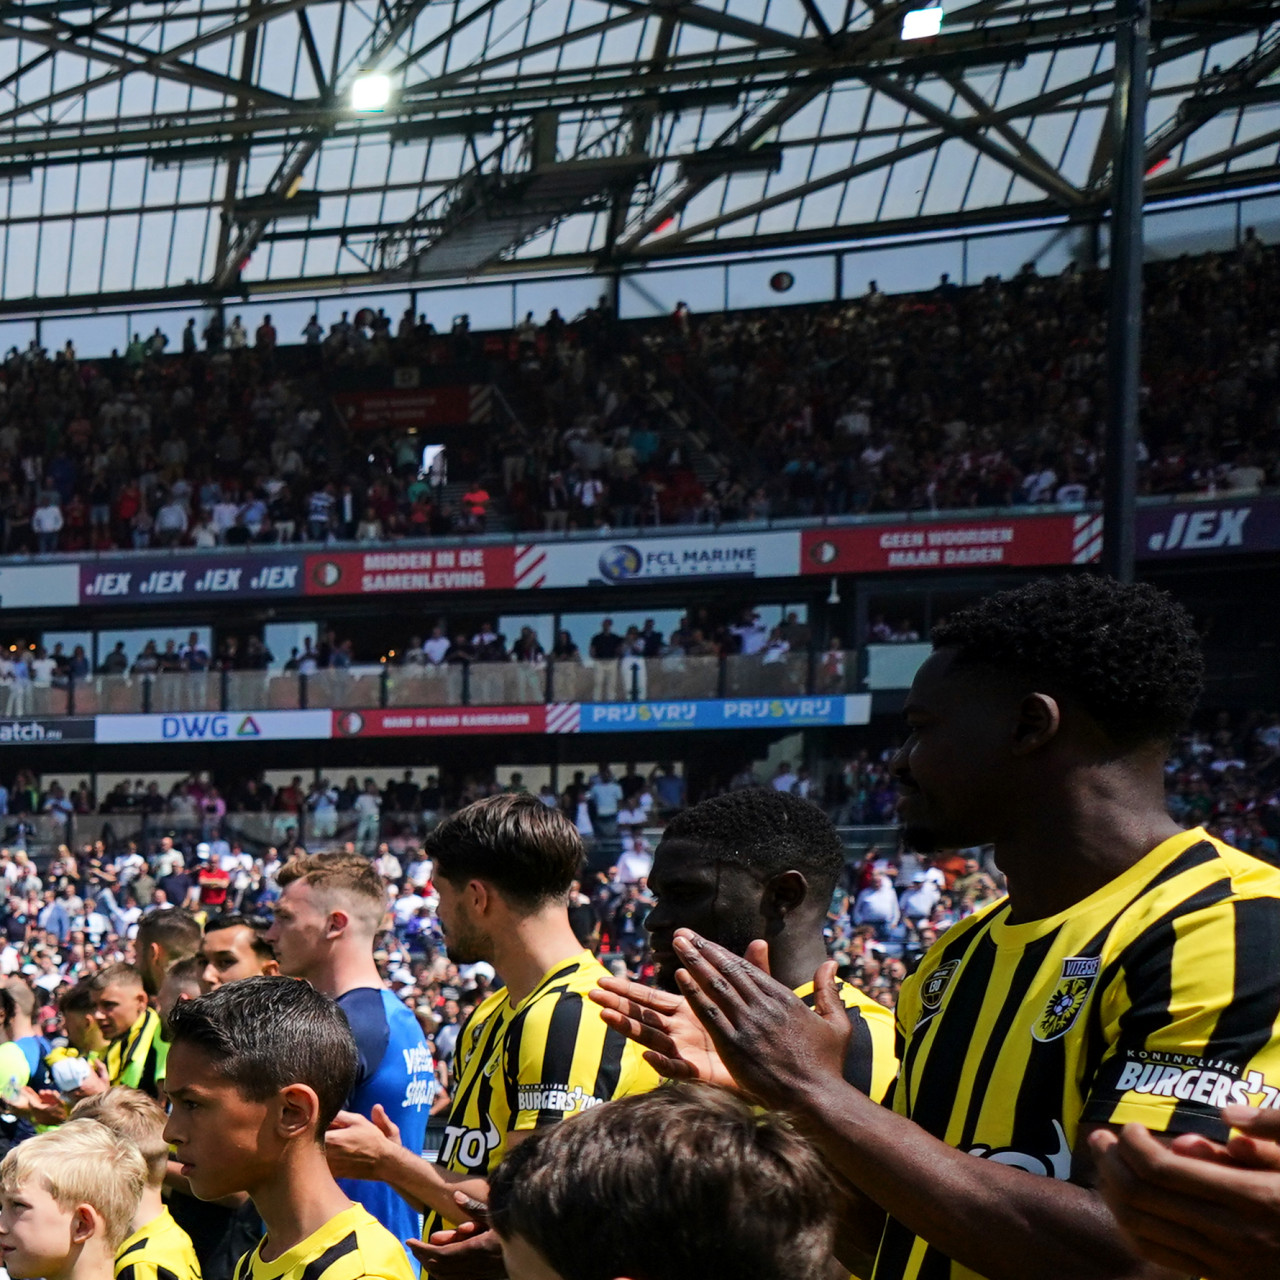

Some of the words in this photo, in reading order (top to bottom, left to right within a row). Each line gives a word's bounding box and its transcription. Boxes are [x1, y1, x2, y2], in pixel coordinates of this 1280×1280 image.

[363, 553, 432, 570] MIDDEN
[436, 551, 455, 568] IN
[460, 550, 484, 567] DE
[682, 547, 756, 563] MARINE
[361, 571, 485, 592] SAMENLEVING
[161, 715, 229, 740] DWG
[1065, 959, 1100, 977] VITESSE
[1126, 1049, 1241, 1076] KONINKLIJKE
